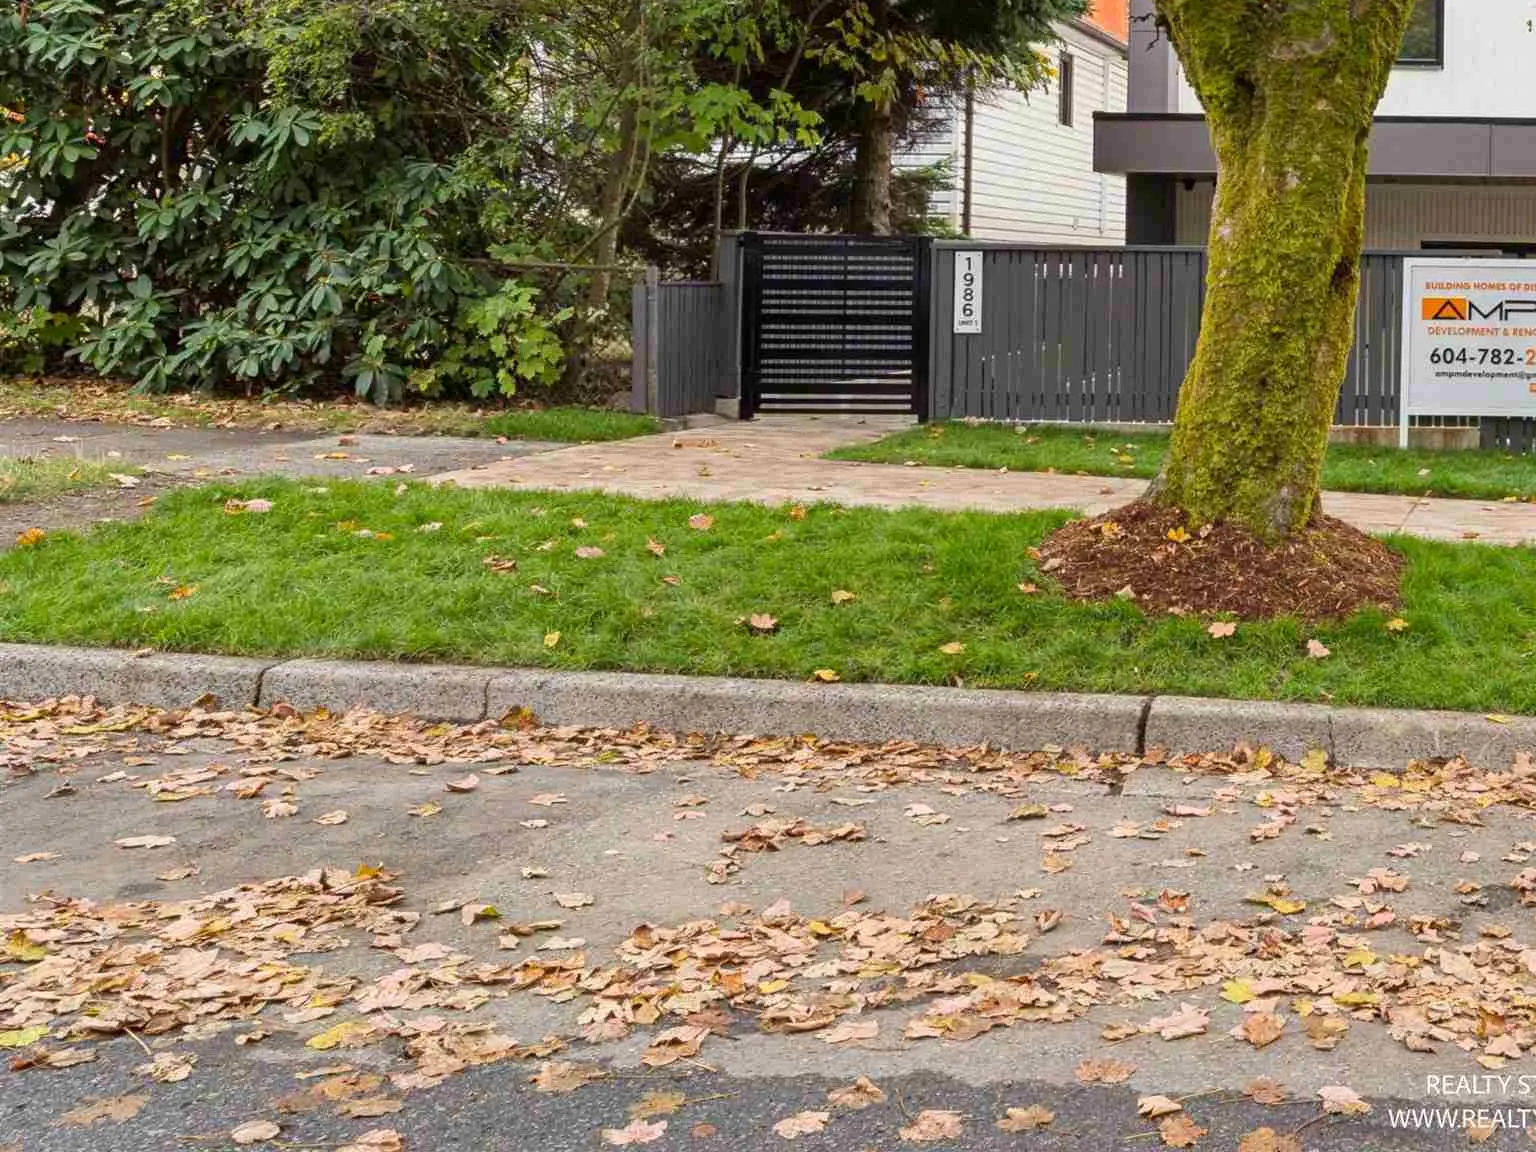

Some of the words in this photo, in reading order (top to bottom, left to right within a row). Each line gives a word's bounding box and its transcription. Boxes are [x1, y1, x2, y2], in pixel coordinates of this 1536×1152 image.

[962, 256, 974, 317] 1986
[1425, 281, 1471, 290] BUILDING
[1473, 282, 1506, 291] HOMES
[1508, 283, 1522, 291] OF
[1427, 327, 1499, 336] DEVELOPMENT
[1503, 328, 1510, 336] &
